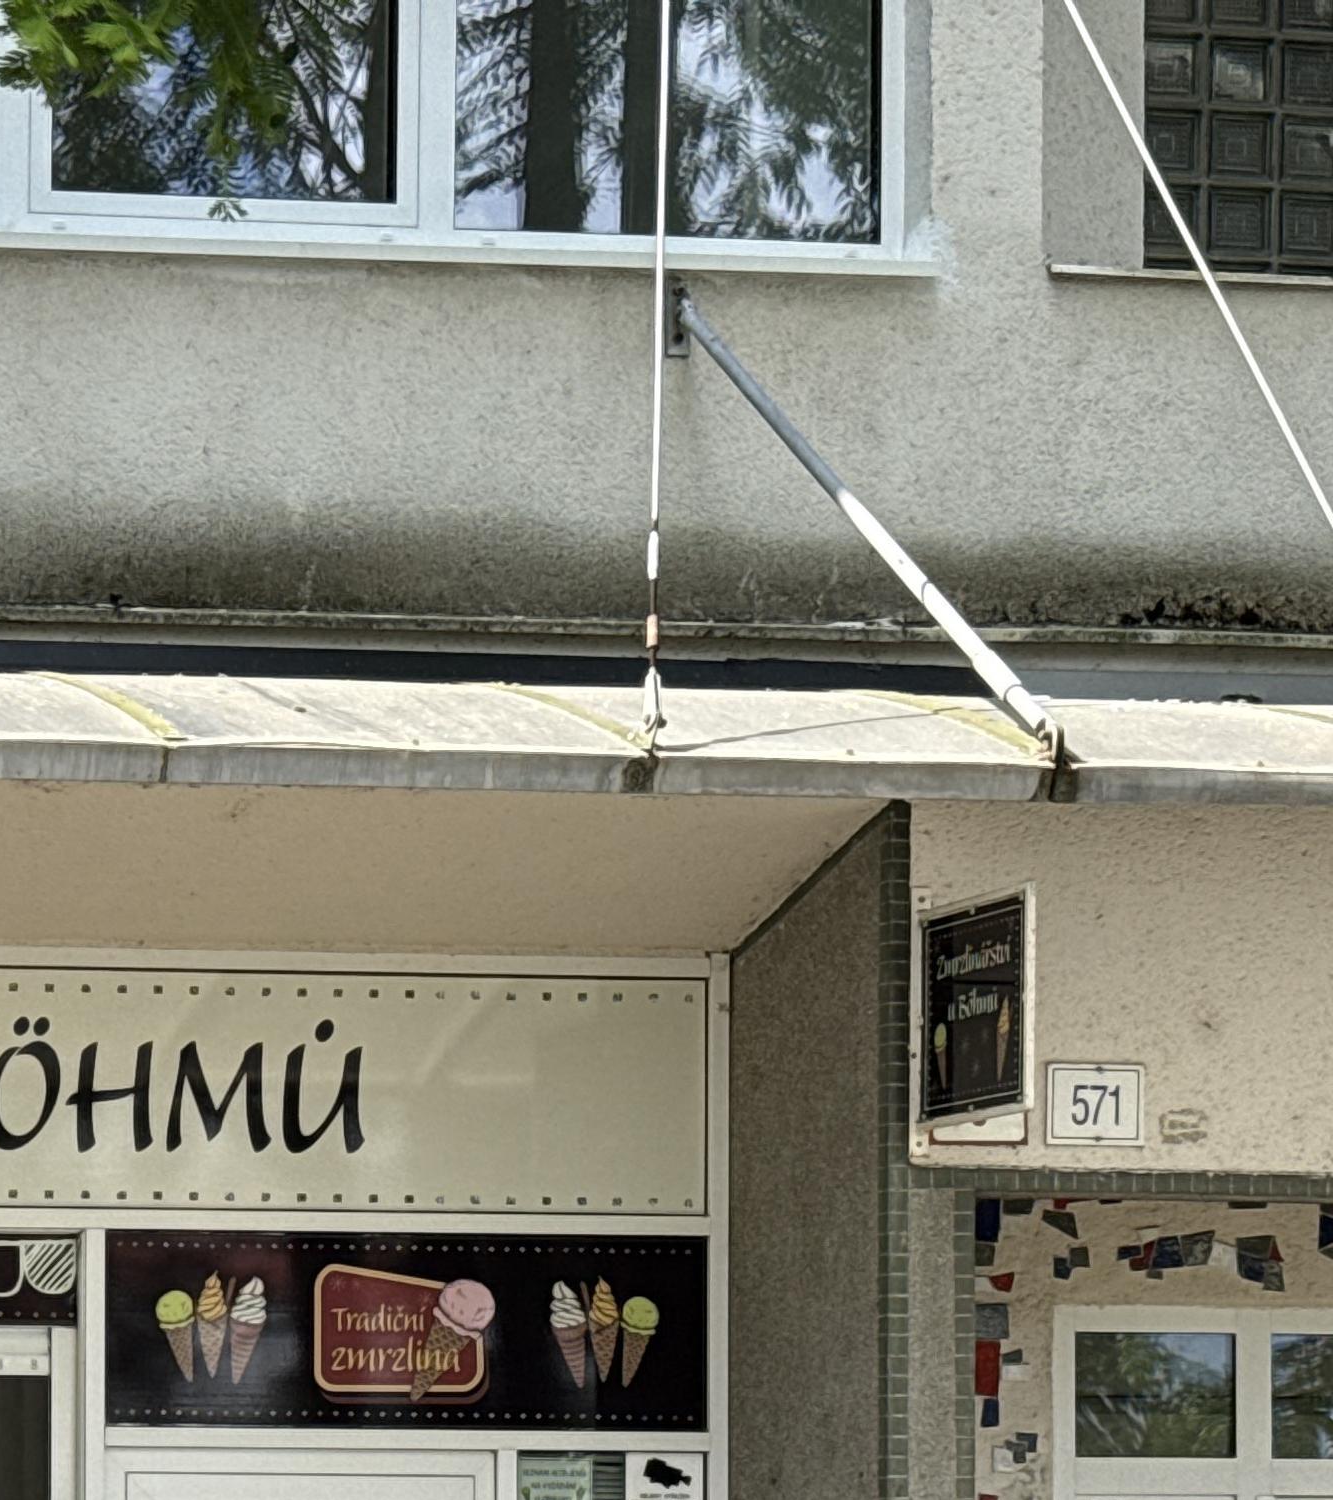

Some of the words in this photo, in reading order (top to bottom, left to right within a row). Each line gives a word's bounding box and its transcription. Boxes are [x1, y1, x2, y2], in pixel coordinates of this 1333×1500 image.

[1071, 1084, 1121, 1127] 571
[330, 1304, 428, 1335] Tradiční
[330, 1341, 461, 1375] zmrzlina
